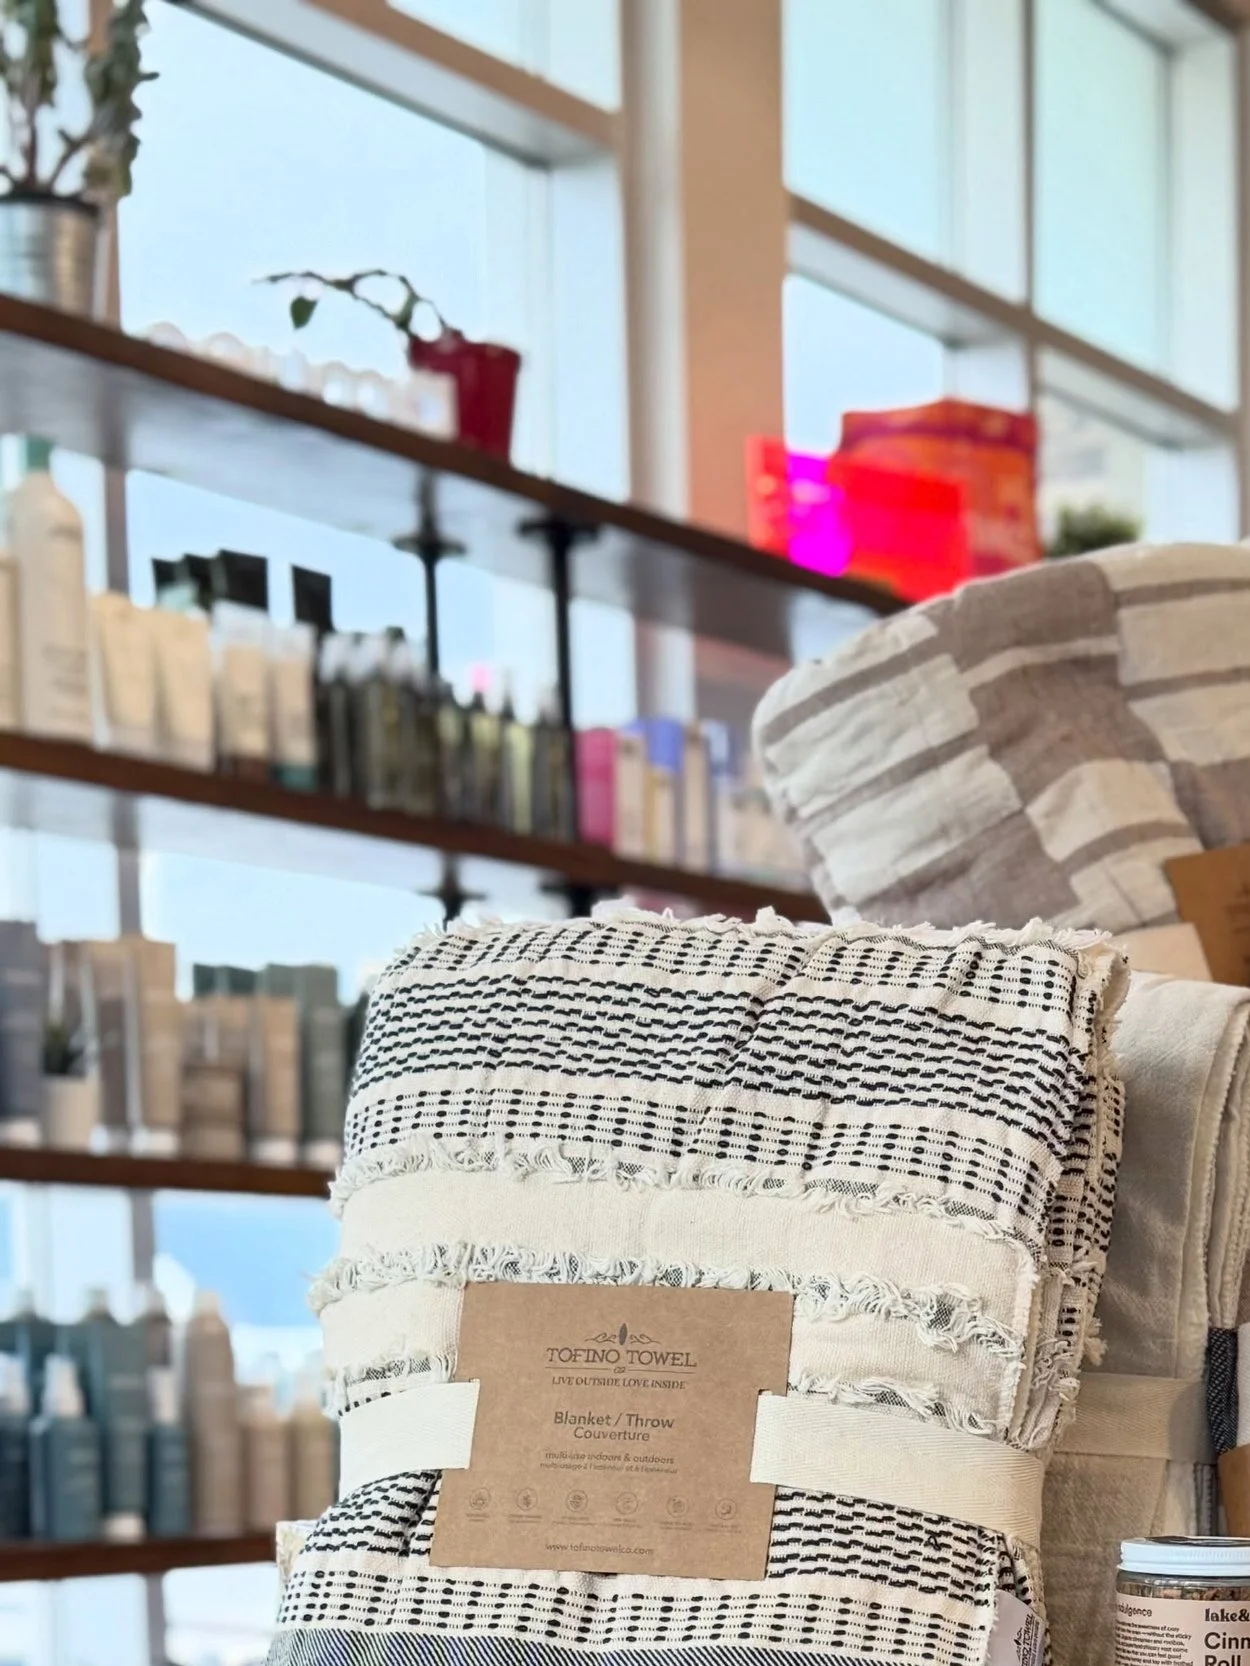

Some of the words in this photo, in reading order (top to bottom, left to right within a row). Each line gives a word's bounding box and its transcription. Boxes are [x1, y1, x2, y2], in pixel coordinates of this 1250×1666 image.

[546, 1347, 620, 1364] TOFINO
[626, 1350, 698, 1367] TOWEL
[551, 1375, 574, 1386] LIVE
[575, 1376, 620, 1387] OUTSIDE
[622, 1378, 649, 1389] LOVE
[650, 1379, 687, 1390] INSIDE
[553, 1410, 612, 1426] Blanket
[614, 1412, 623, 1427] /
[625, 1413, 676, 1429] Throw
[573, 1426, 650, 1442] Couverture
[632, 1455, 675, 1465] outdoors
